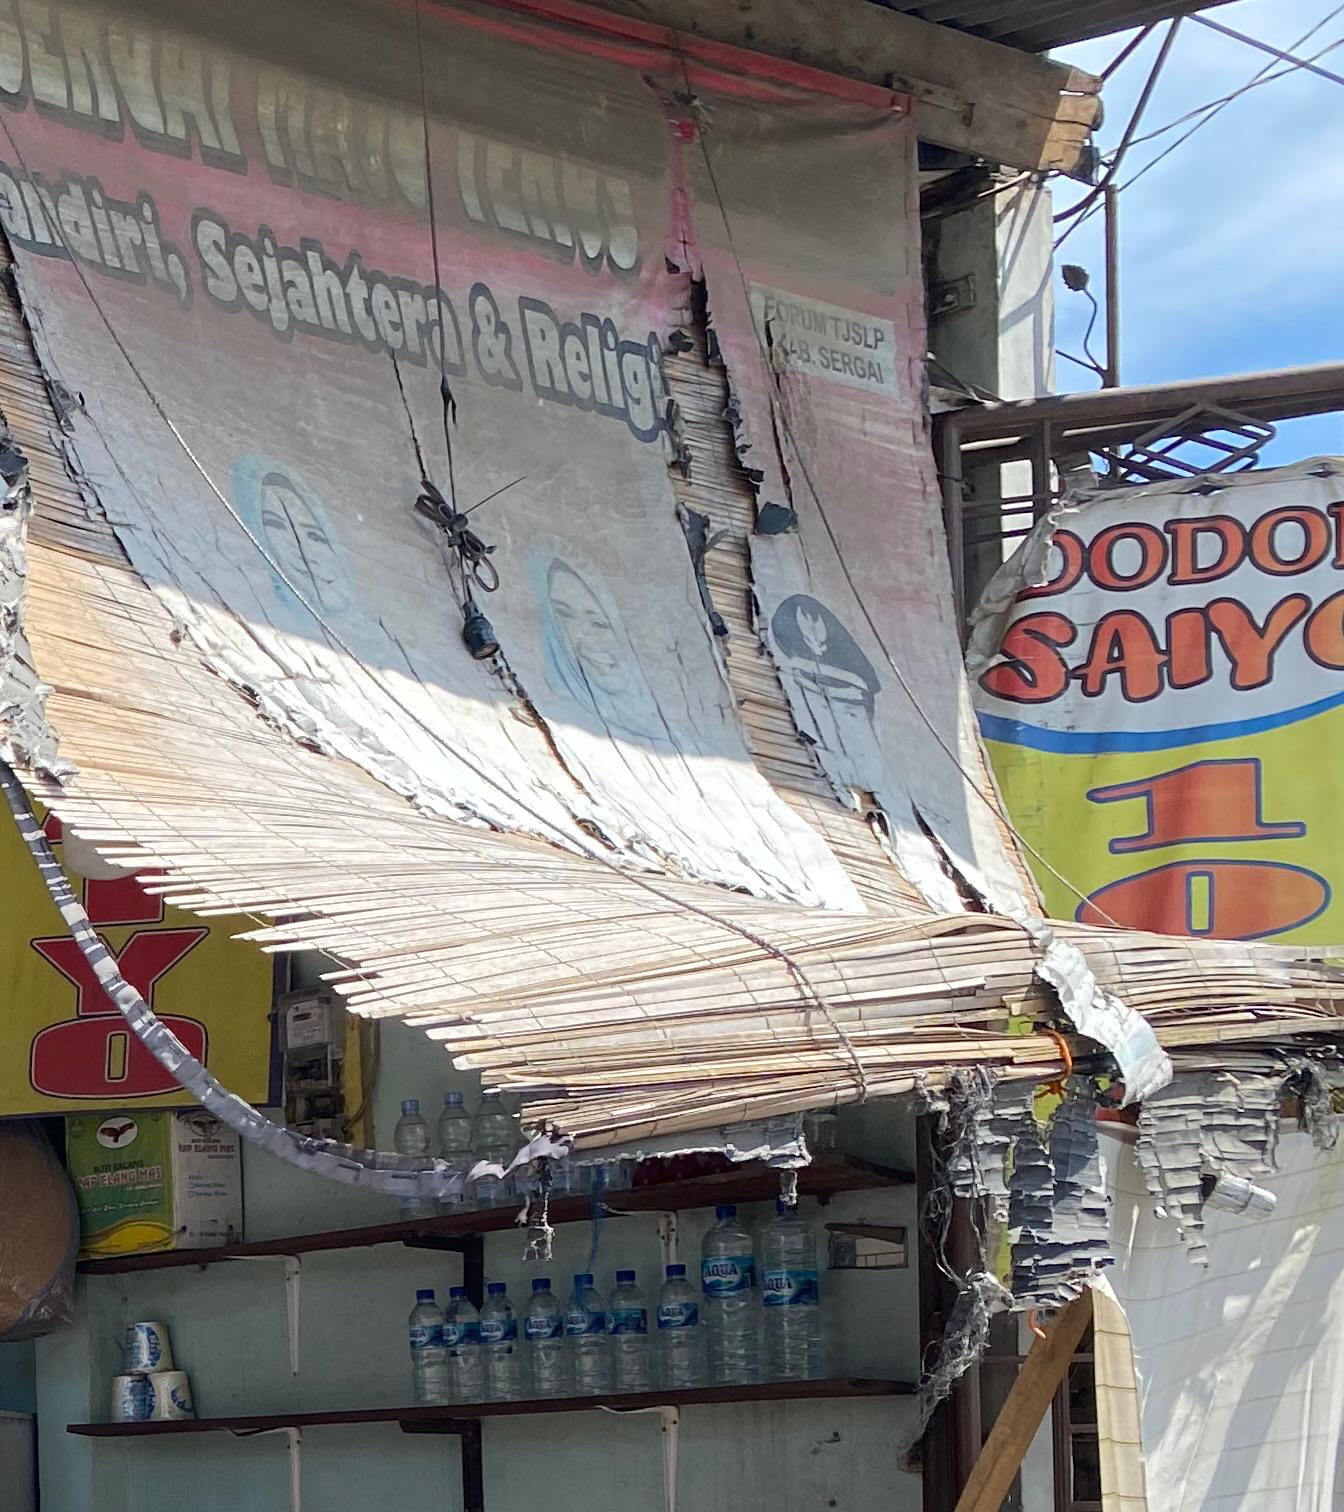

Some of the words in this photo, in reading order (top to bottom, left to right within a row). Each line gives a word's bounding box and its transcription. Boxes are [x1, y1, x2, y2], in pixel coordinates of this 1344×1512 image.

[196, 219, 460, 366] Sejahtera
[474, 290, 520, 380] &
[523, 303, 664, 430] Religi
[764, 296, 827, 335] FORUM
[833, 317, 885, 350] TJSLP
[818, 347, 884, 384] SERGAI
[1016, 506, 1344, 600] DODO
[101, 1169, 136, 1187] ELANG
[138, 1166, 162, 1182] MAS
[704, 1263, 739, 1278] AQUA
